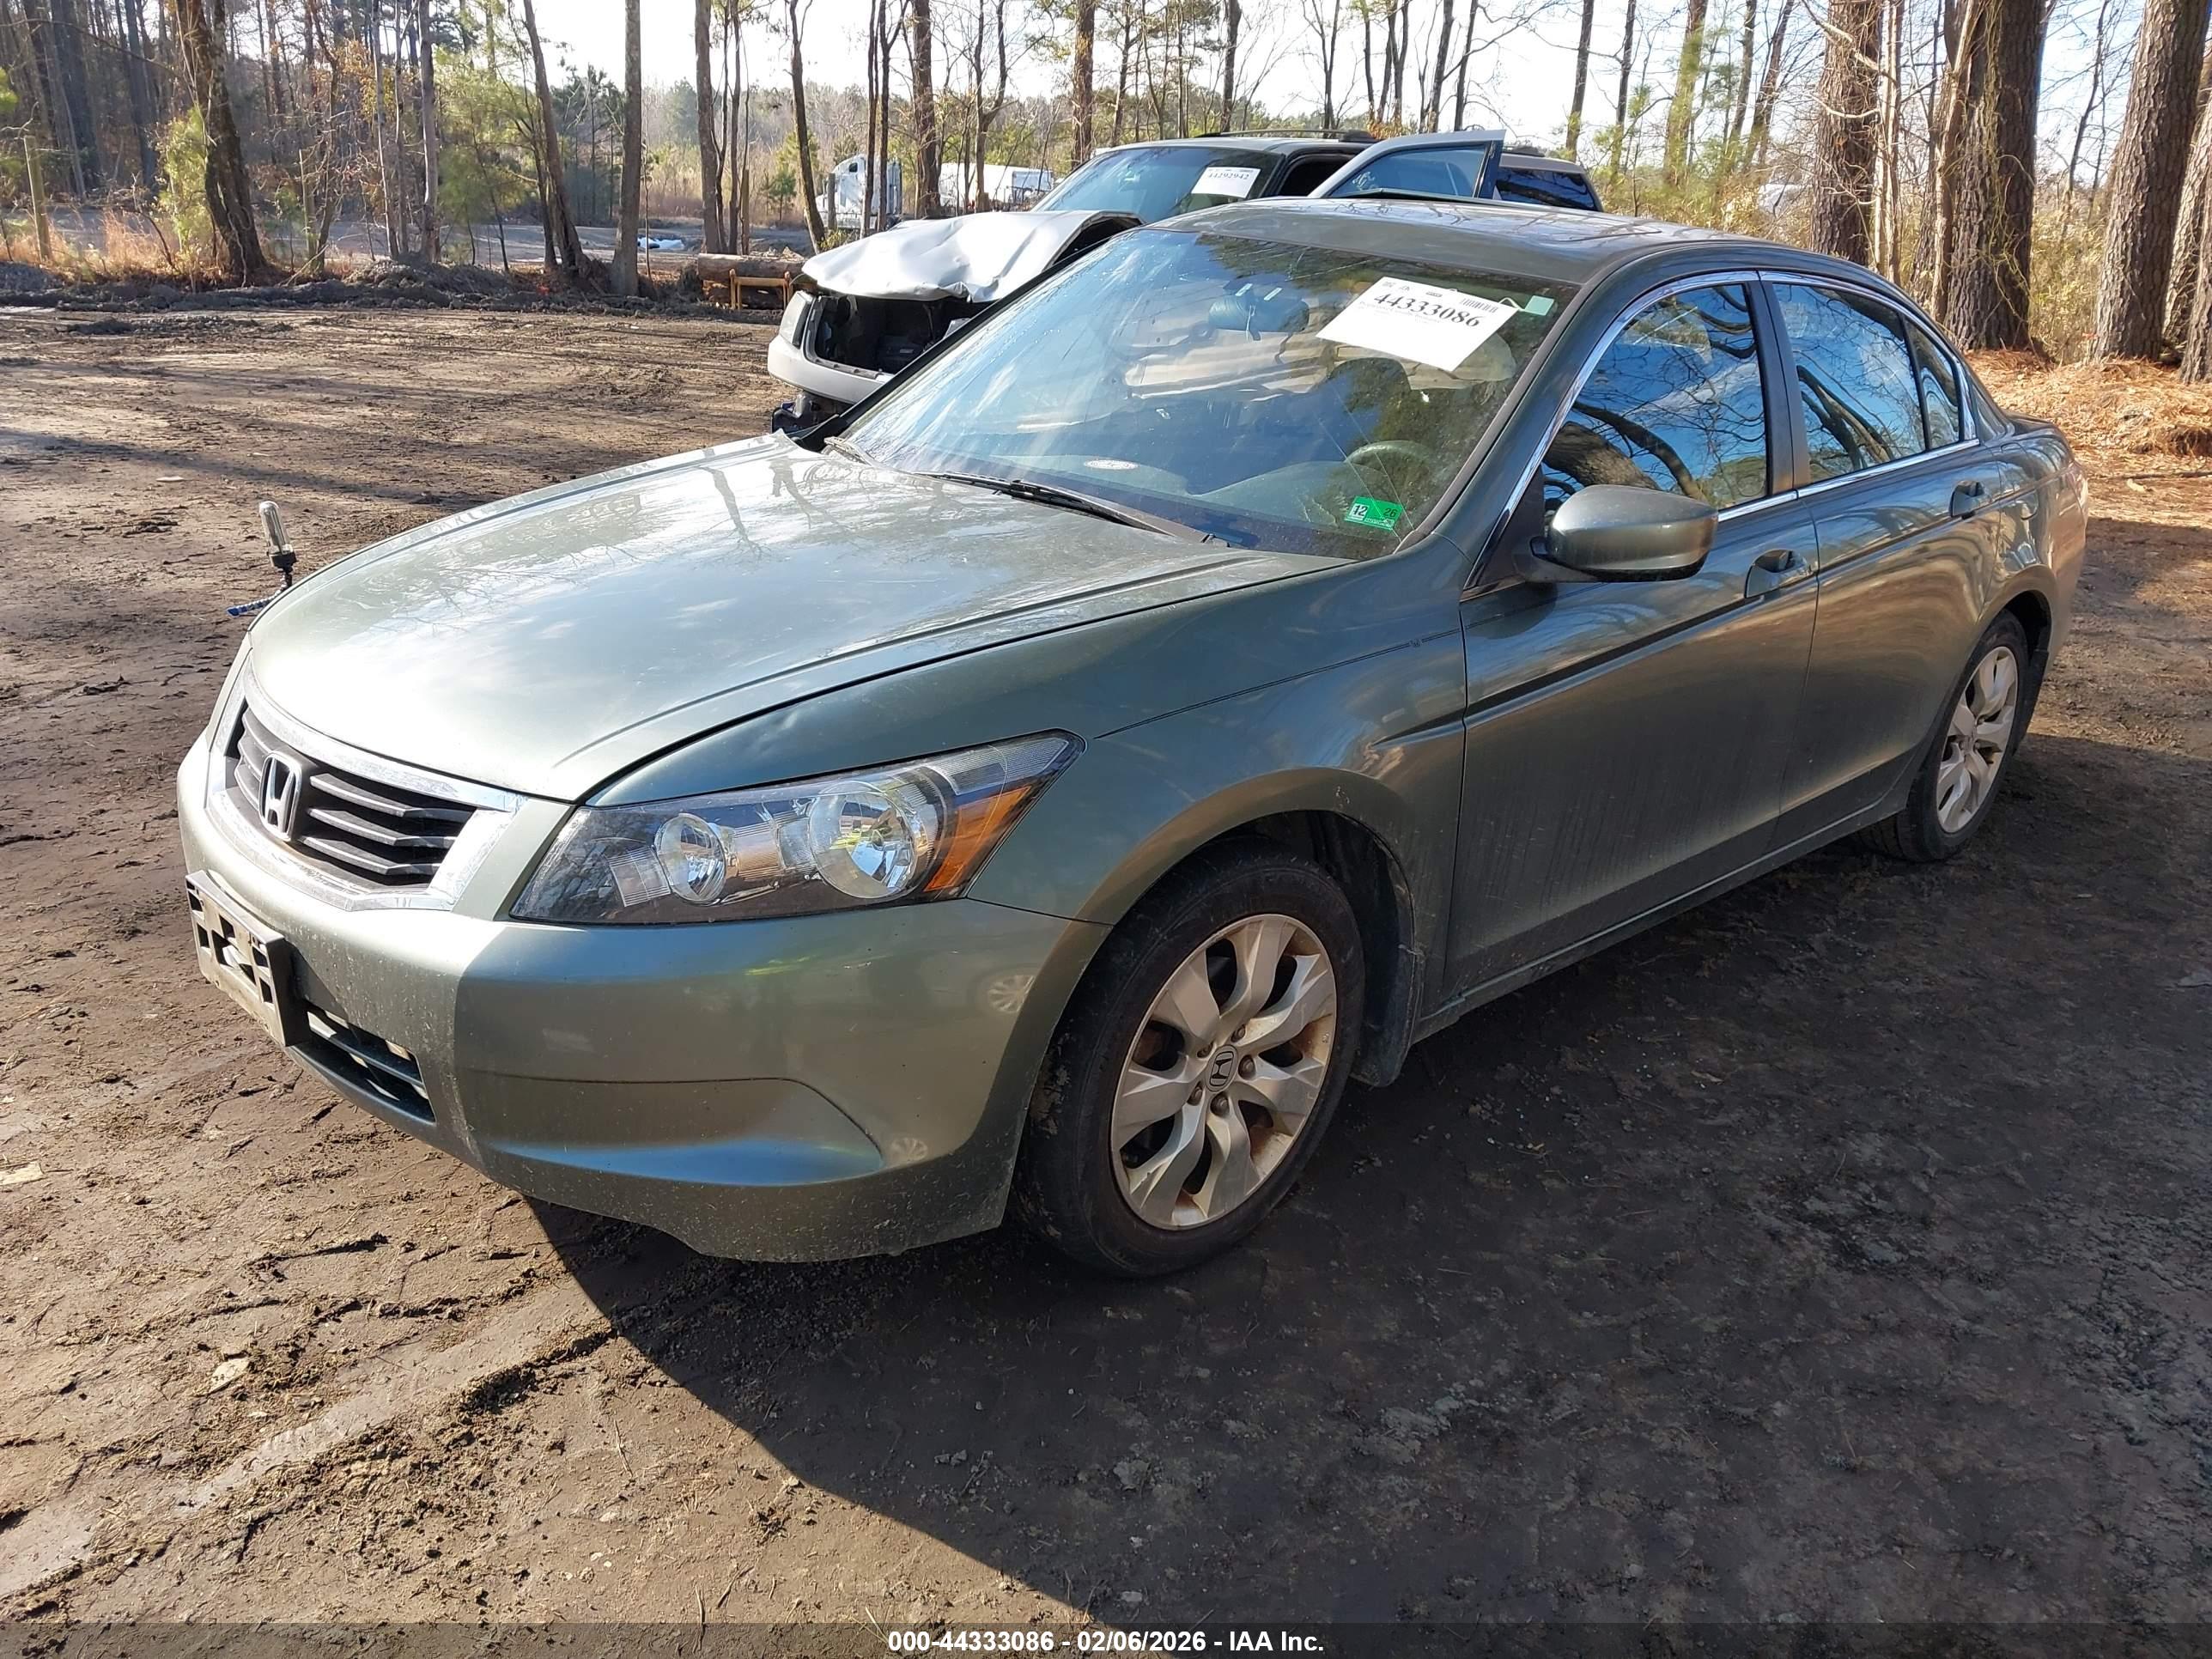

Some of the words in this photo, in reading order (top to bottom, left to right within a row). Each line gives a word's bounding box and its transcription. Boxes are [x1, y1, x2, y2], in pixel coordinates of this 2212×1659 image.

[1373, 293, 1485, 327] 44333086
[1353, 505, 1369, 516] 12
[1383, 507, 1398, 518] 26
